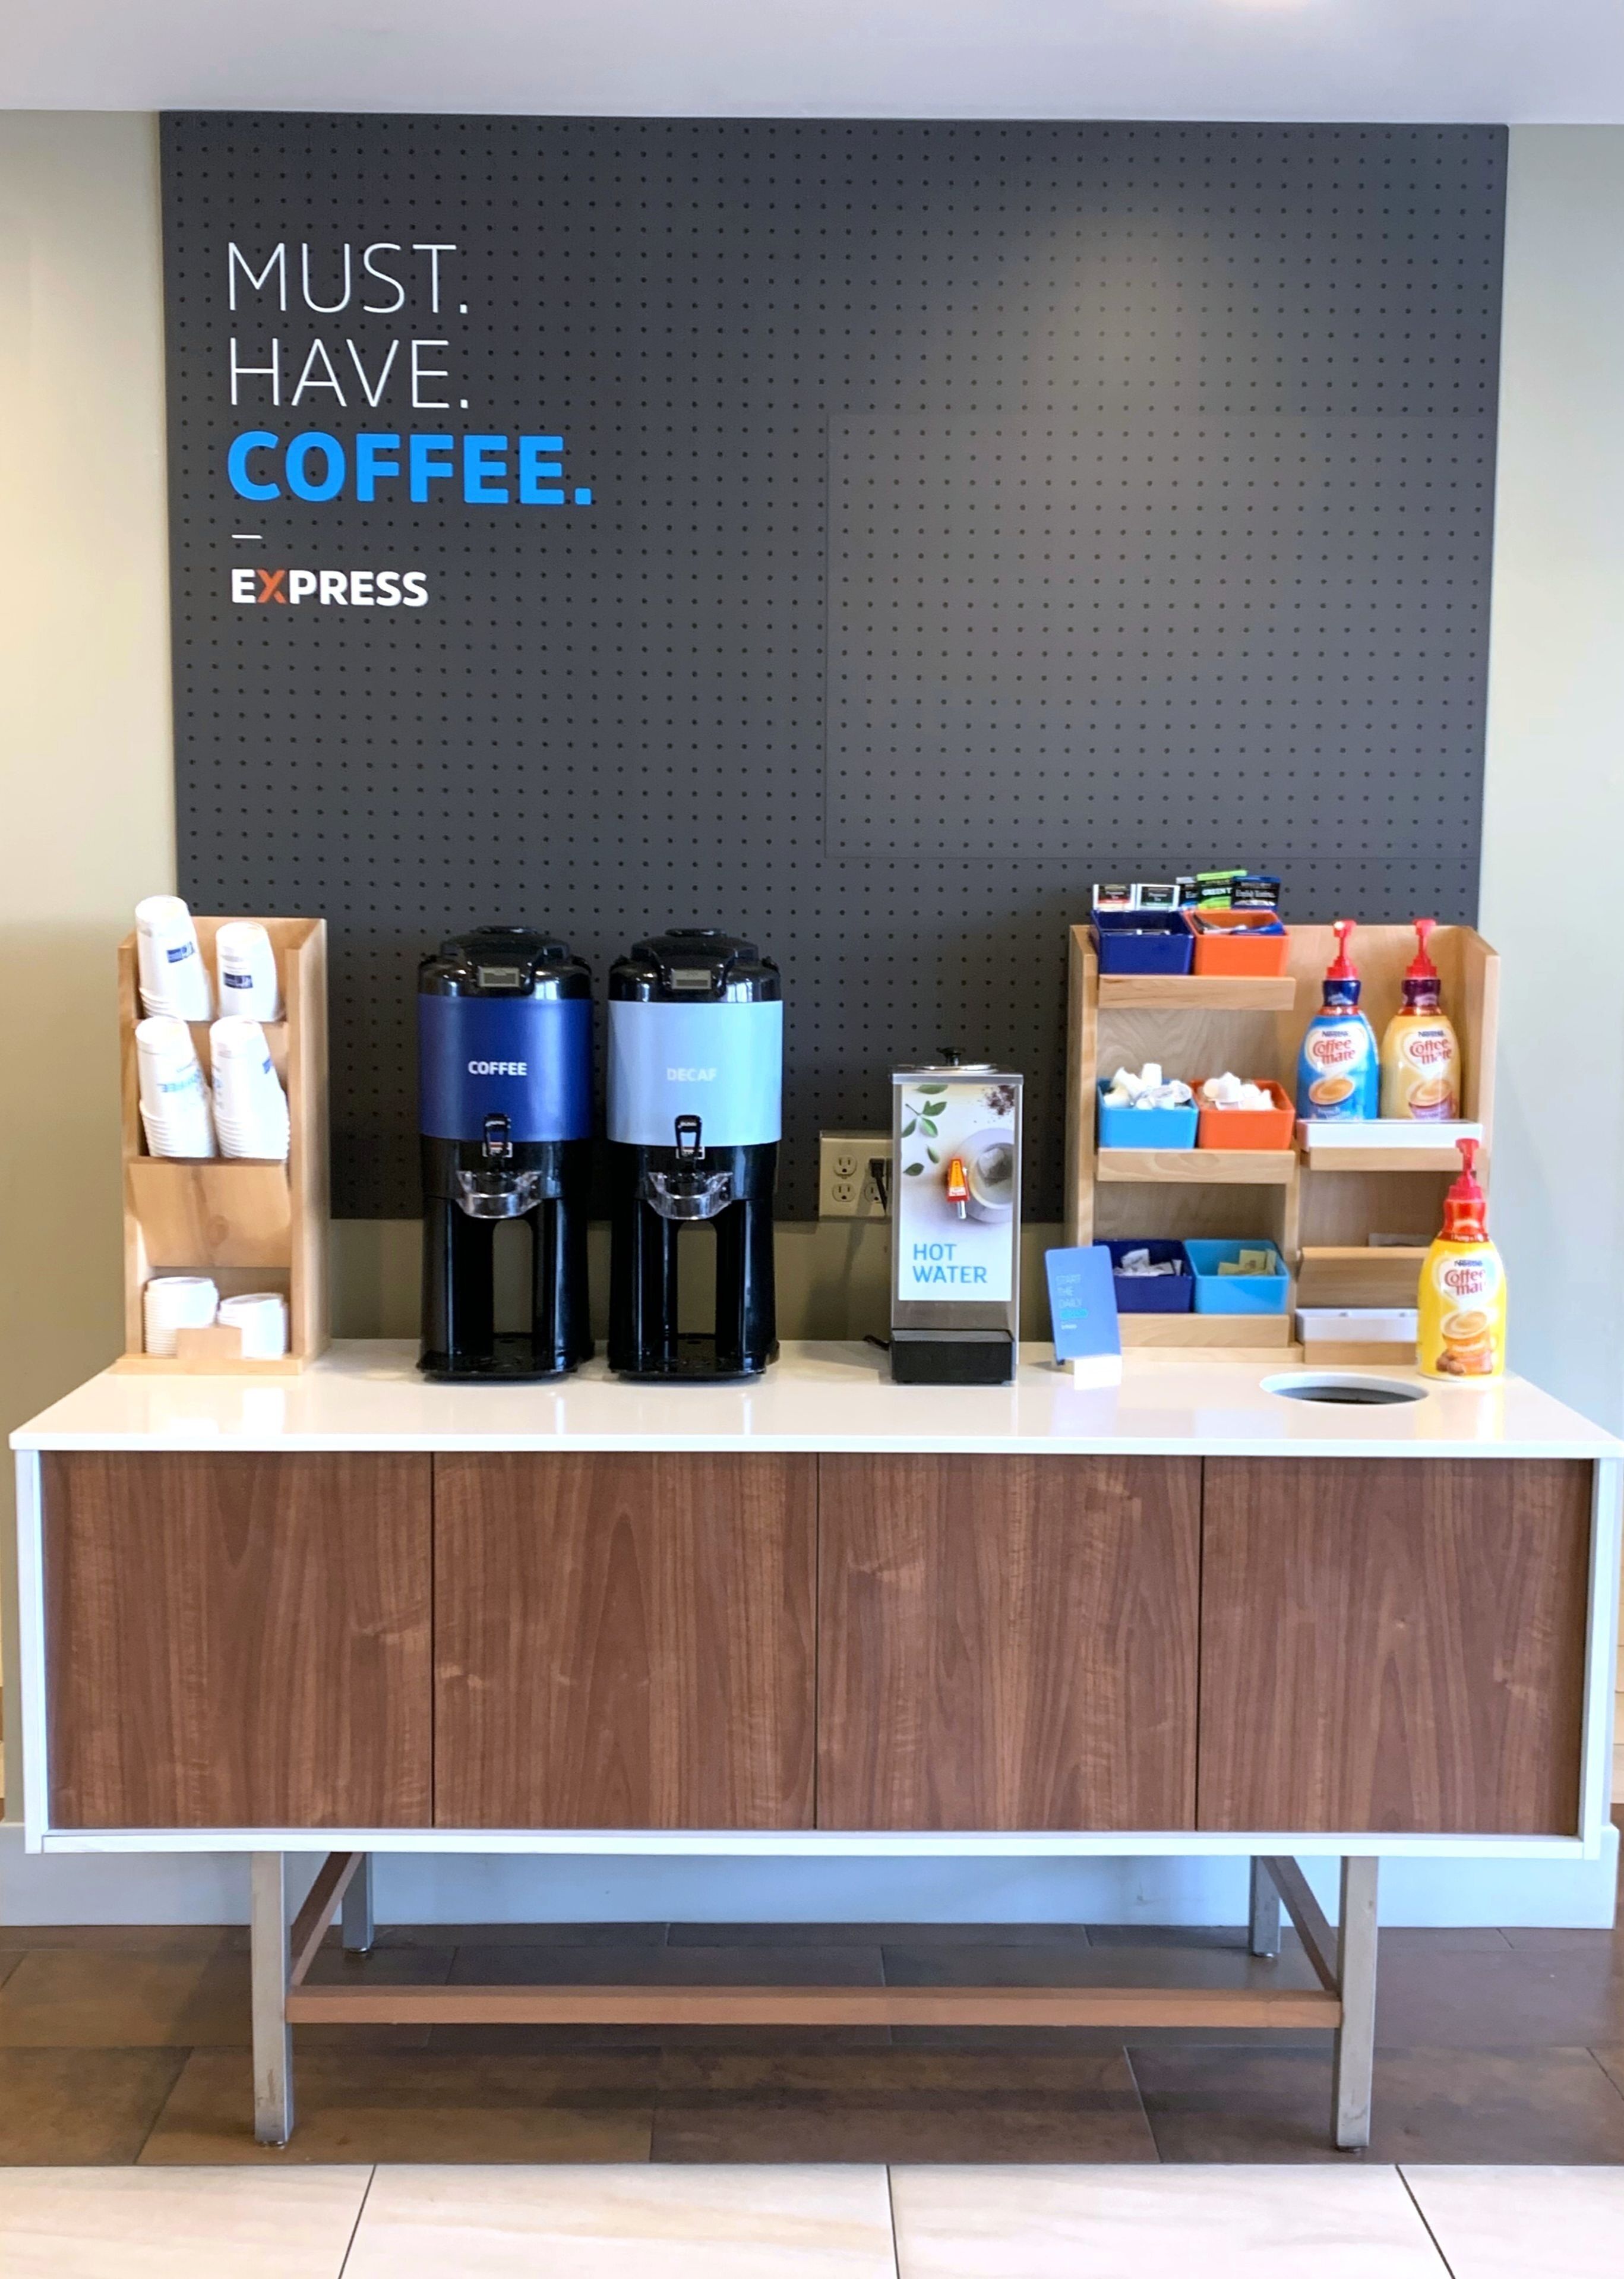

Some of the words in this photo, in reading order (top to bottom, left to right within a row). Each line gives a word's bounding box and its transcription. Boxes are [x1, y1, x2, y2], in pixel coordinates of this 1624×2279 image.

[228, 242, 468, 314] MUST.
[230, 337, 468, 409] HAVE.
[228, 430, 592, 506] COFFEE.
[231, 569, 429, 607] EXPRESS
[1312, 1039, 1352, 1057] Coffee
[1410, 1039, 1449, 1057] Coffee
[1321, 1050, 1356, 1065] mate
[468, 1060, 528, 1076] COFFEE
[666, 1068, 717, 1082] DECAF
[913, 1243, 958, 1261] HOT
[912, 1265, 987, 1283] WATER
